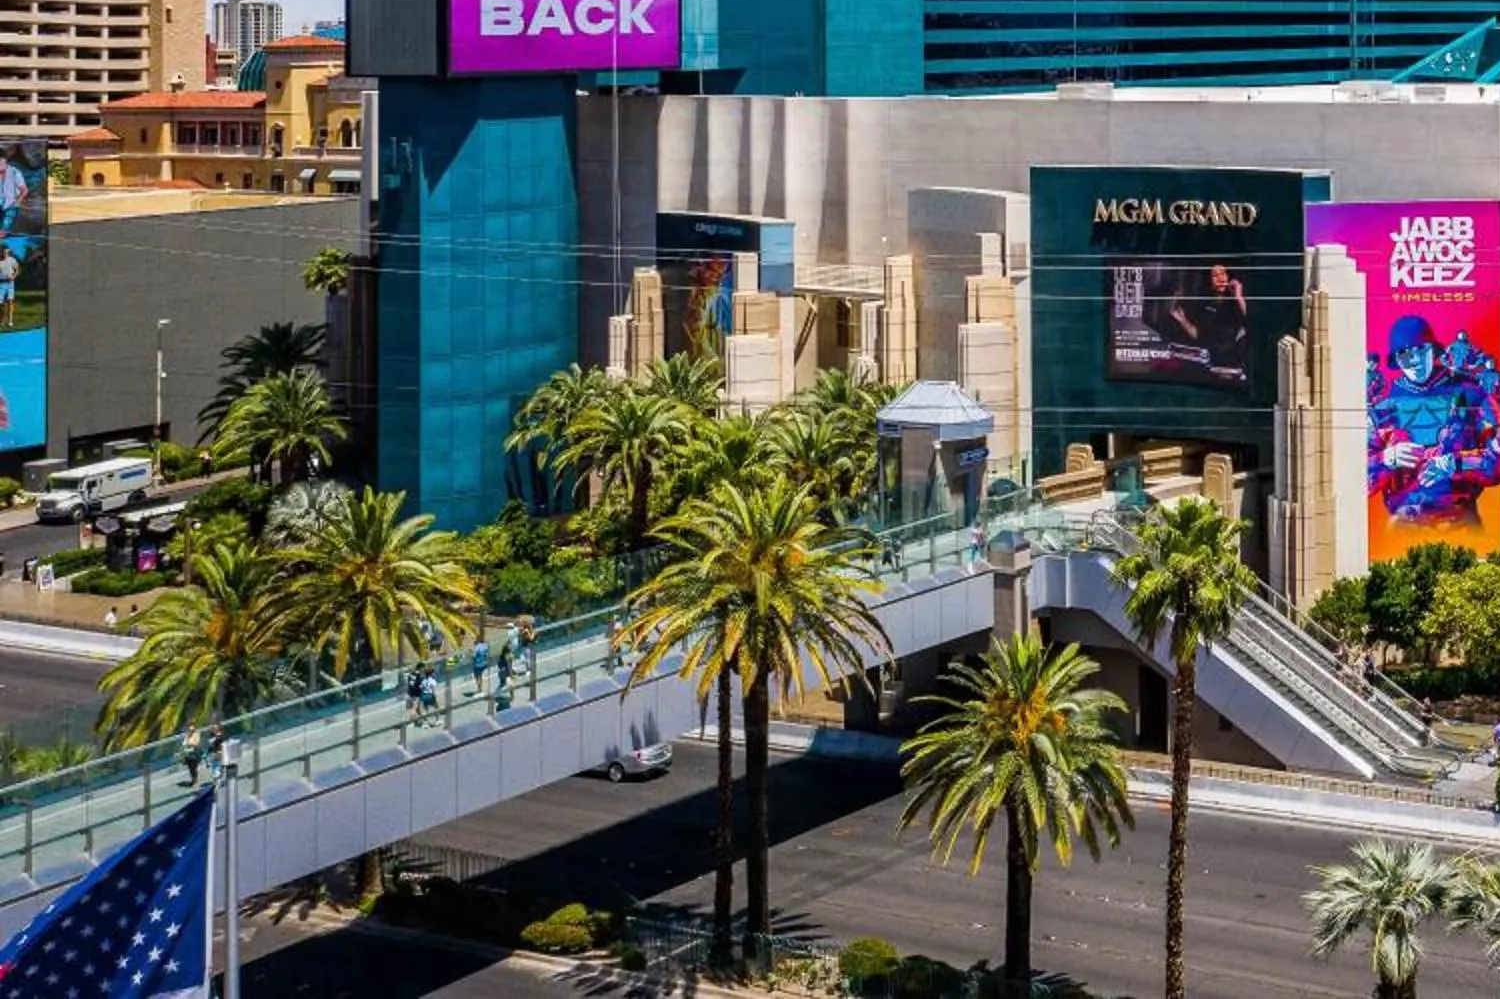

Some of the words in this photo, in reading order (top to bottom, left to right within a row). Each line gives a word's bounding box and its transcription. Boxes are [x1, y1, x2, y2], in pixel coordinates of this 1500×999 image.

[1094, 198, 1165, 223] MGM
[1169, 200, 1257, 228] GRAND
[1389, 216, 1475, 242] JABB
[1391, 241, 1475, 262] AWOC
[1389, 262, 1475, 288] KEEZ
[1392, 291, 1476, 303] TIMELESS
